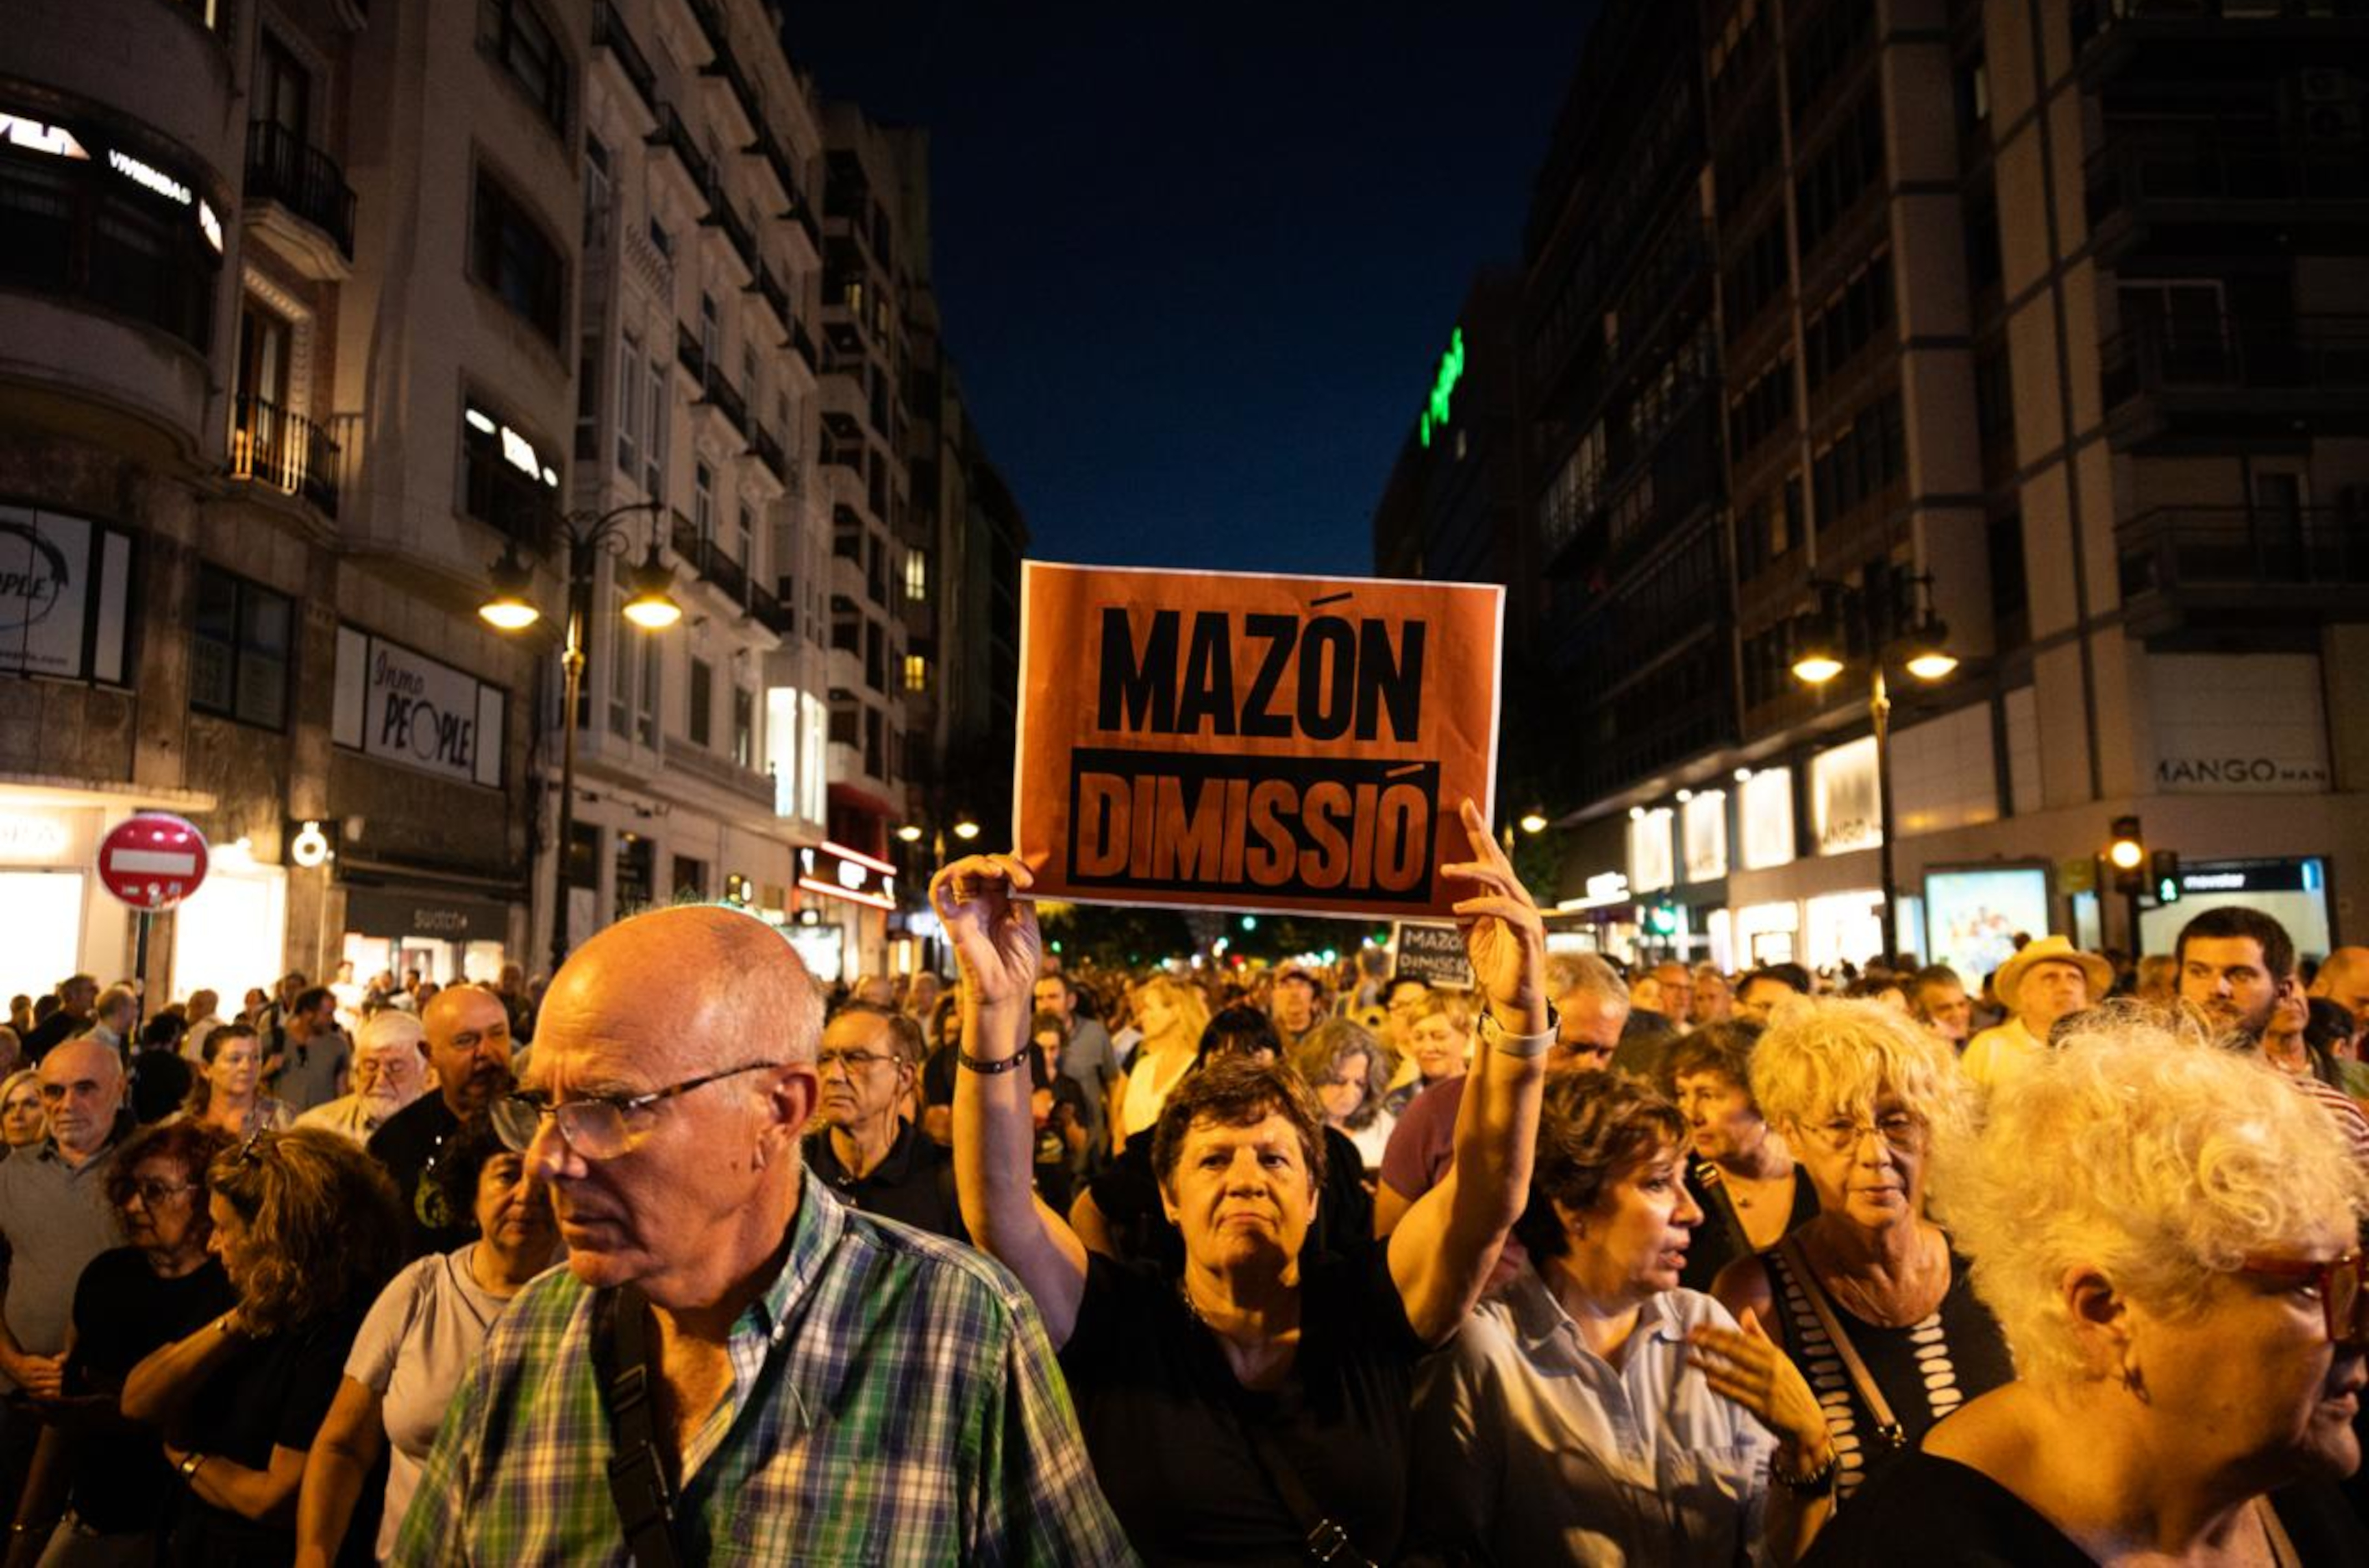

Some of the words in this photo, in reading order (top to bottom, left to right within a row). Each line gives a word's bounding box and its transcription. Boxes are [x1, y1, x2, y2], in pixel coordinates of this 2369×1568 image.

[1097, 592, 1425, 742] MAZÓN
[380, 692, 472, 766] PEOPLE
[2281, 770, 2326, 781] MAN
[1076, 763, 1428, 893] DIMISSIÓ
